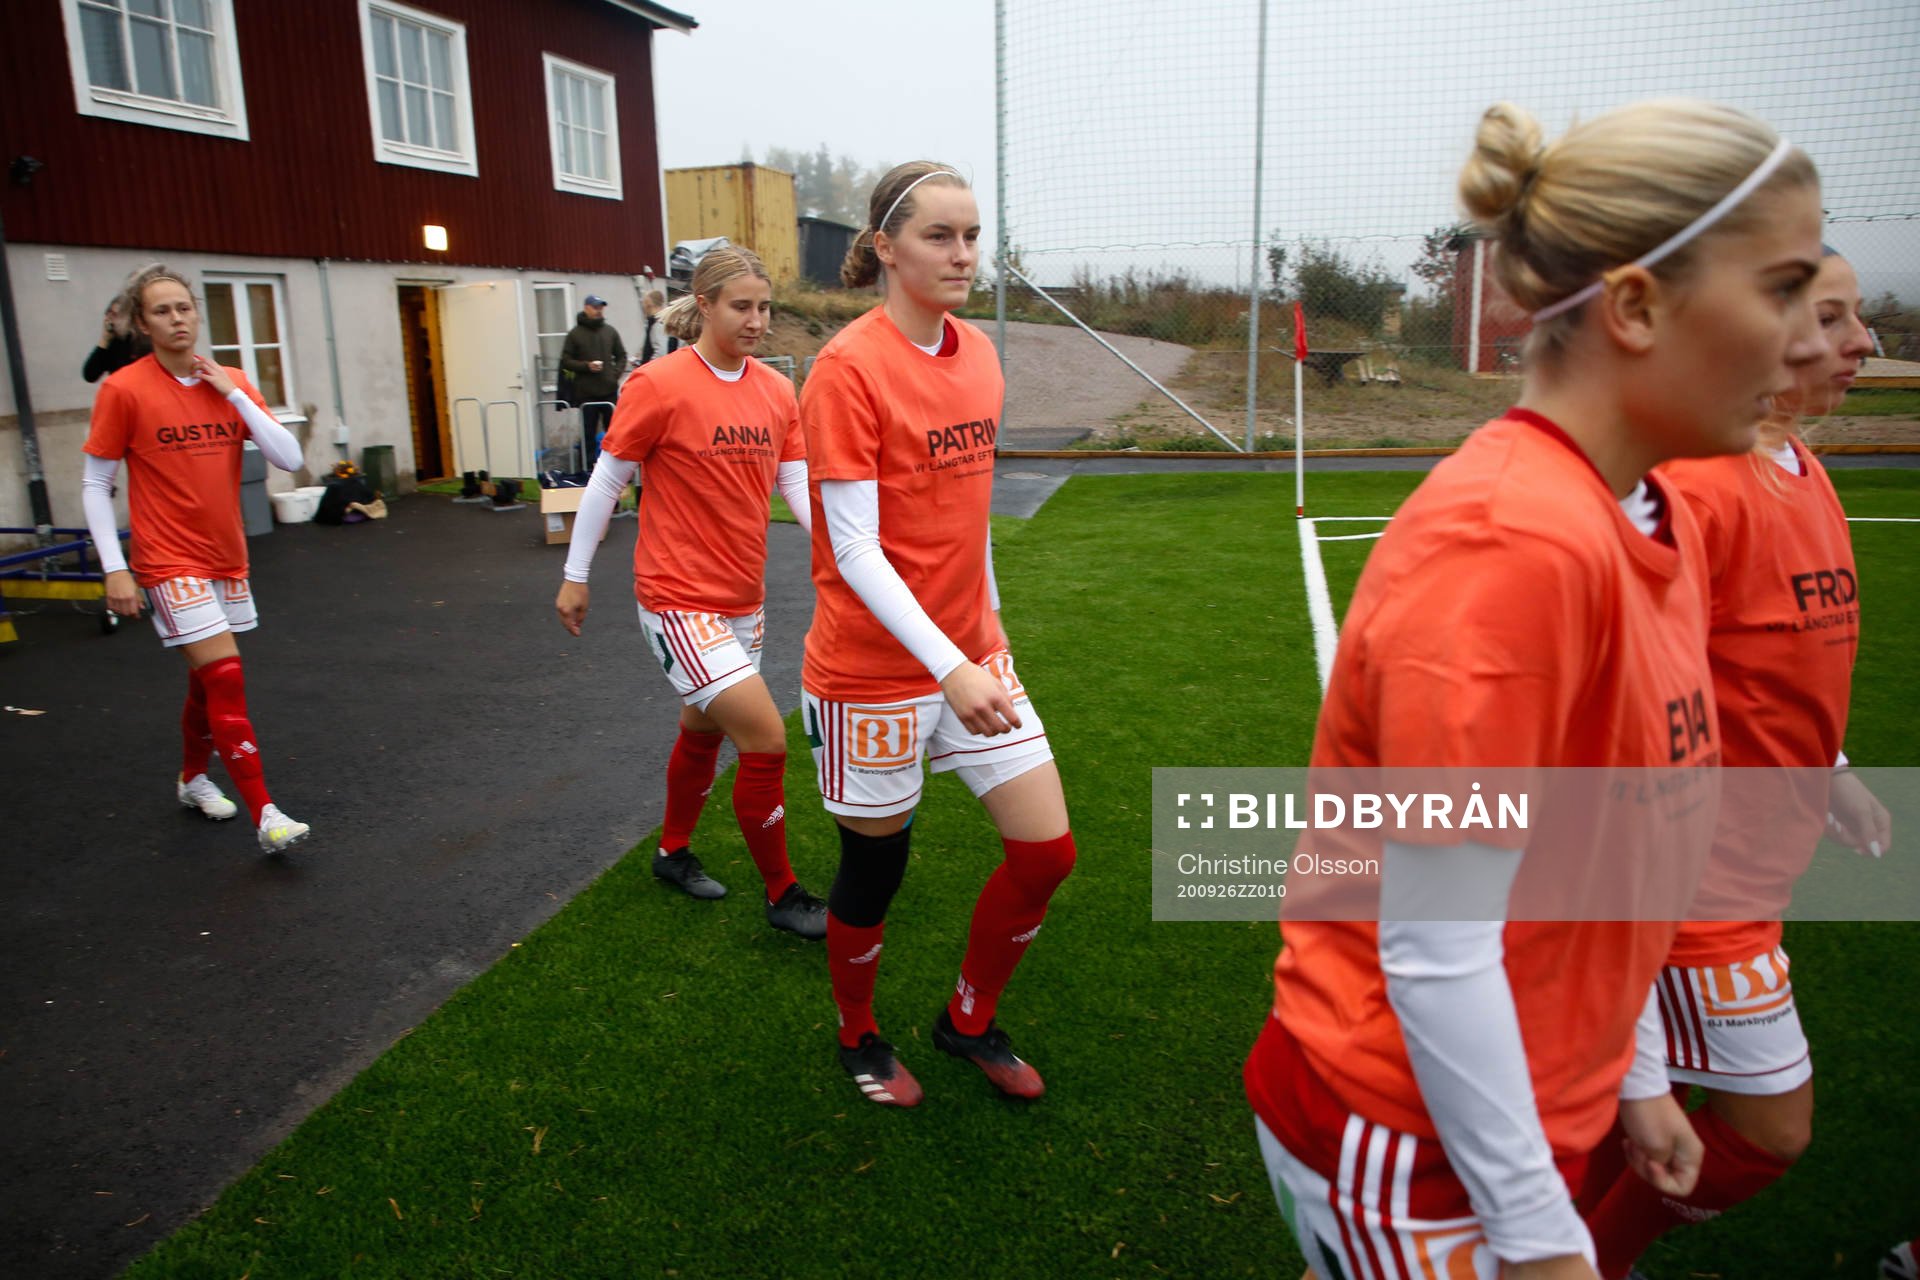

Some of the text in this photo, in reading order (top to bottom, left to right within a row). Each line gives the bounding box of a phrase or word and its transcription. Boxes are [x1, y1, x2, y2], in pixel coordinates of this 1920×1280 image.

[157, 422, 239, 444] GUSTAV
[712, 425, 772, 447] ANNA
[929, 454, 975, 471] LÅNGTAR
[1666, 688, 1711, 763] EVA
[857, 718, 909, 759] BJ
